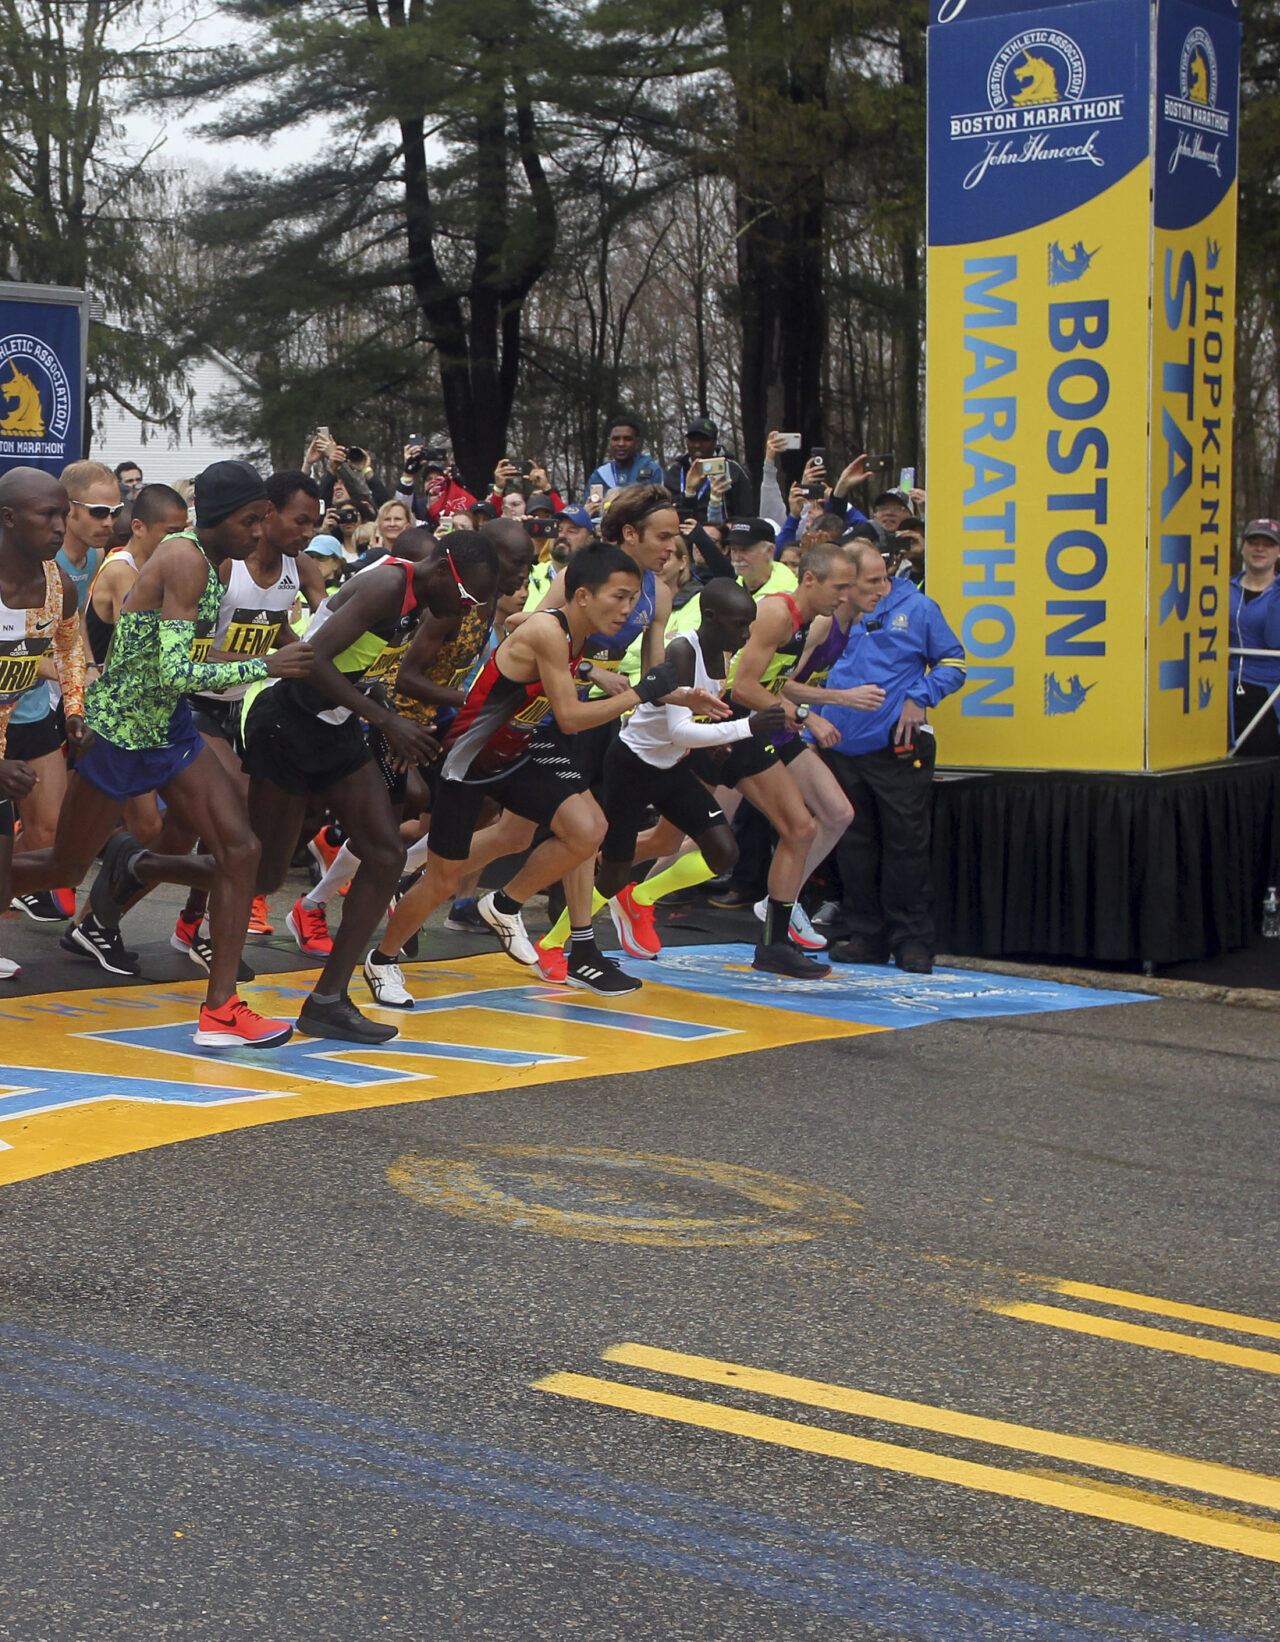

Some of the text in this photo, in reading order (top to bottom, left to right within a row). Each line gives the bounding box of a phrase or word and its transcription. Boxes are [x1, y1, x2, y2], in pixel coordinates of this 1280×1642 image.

[991, 32, 1083, 105] BOSTON ATHLETIC ASSOCIATION
[950, 100, 1121, 137] BOSTON MARATHON
[1164, 99, 1230, 132] BOSTON MARATHON
[963, 130, 1105, 190] John Hancock
[34, 345, 68, 431] ASSOCIATION
[17, 440, 64, 454] MARATHON
[961, 255, 1018, 718] MARATHON
[1045, 299, 1109, 657] BOSTON
[1158, 247, 1197, 714] START
[1198, 284, 1224, 663] HOPKINTON
